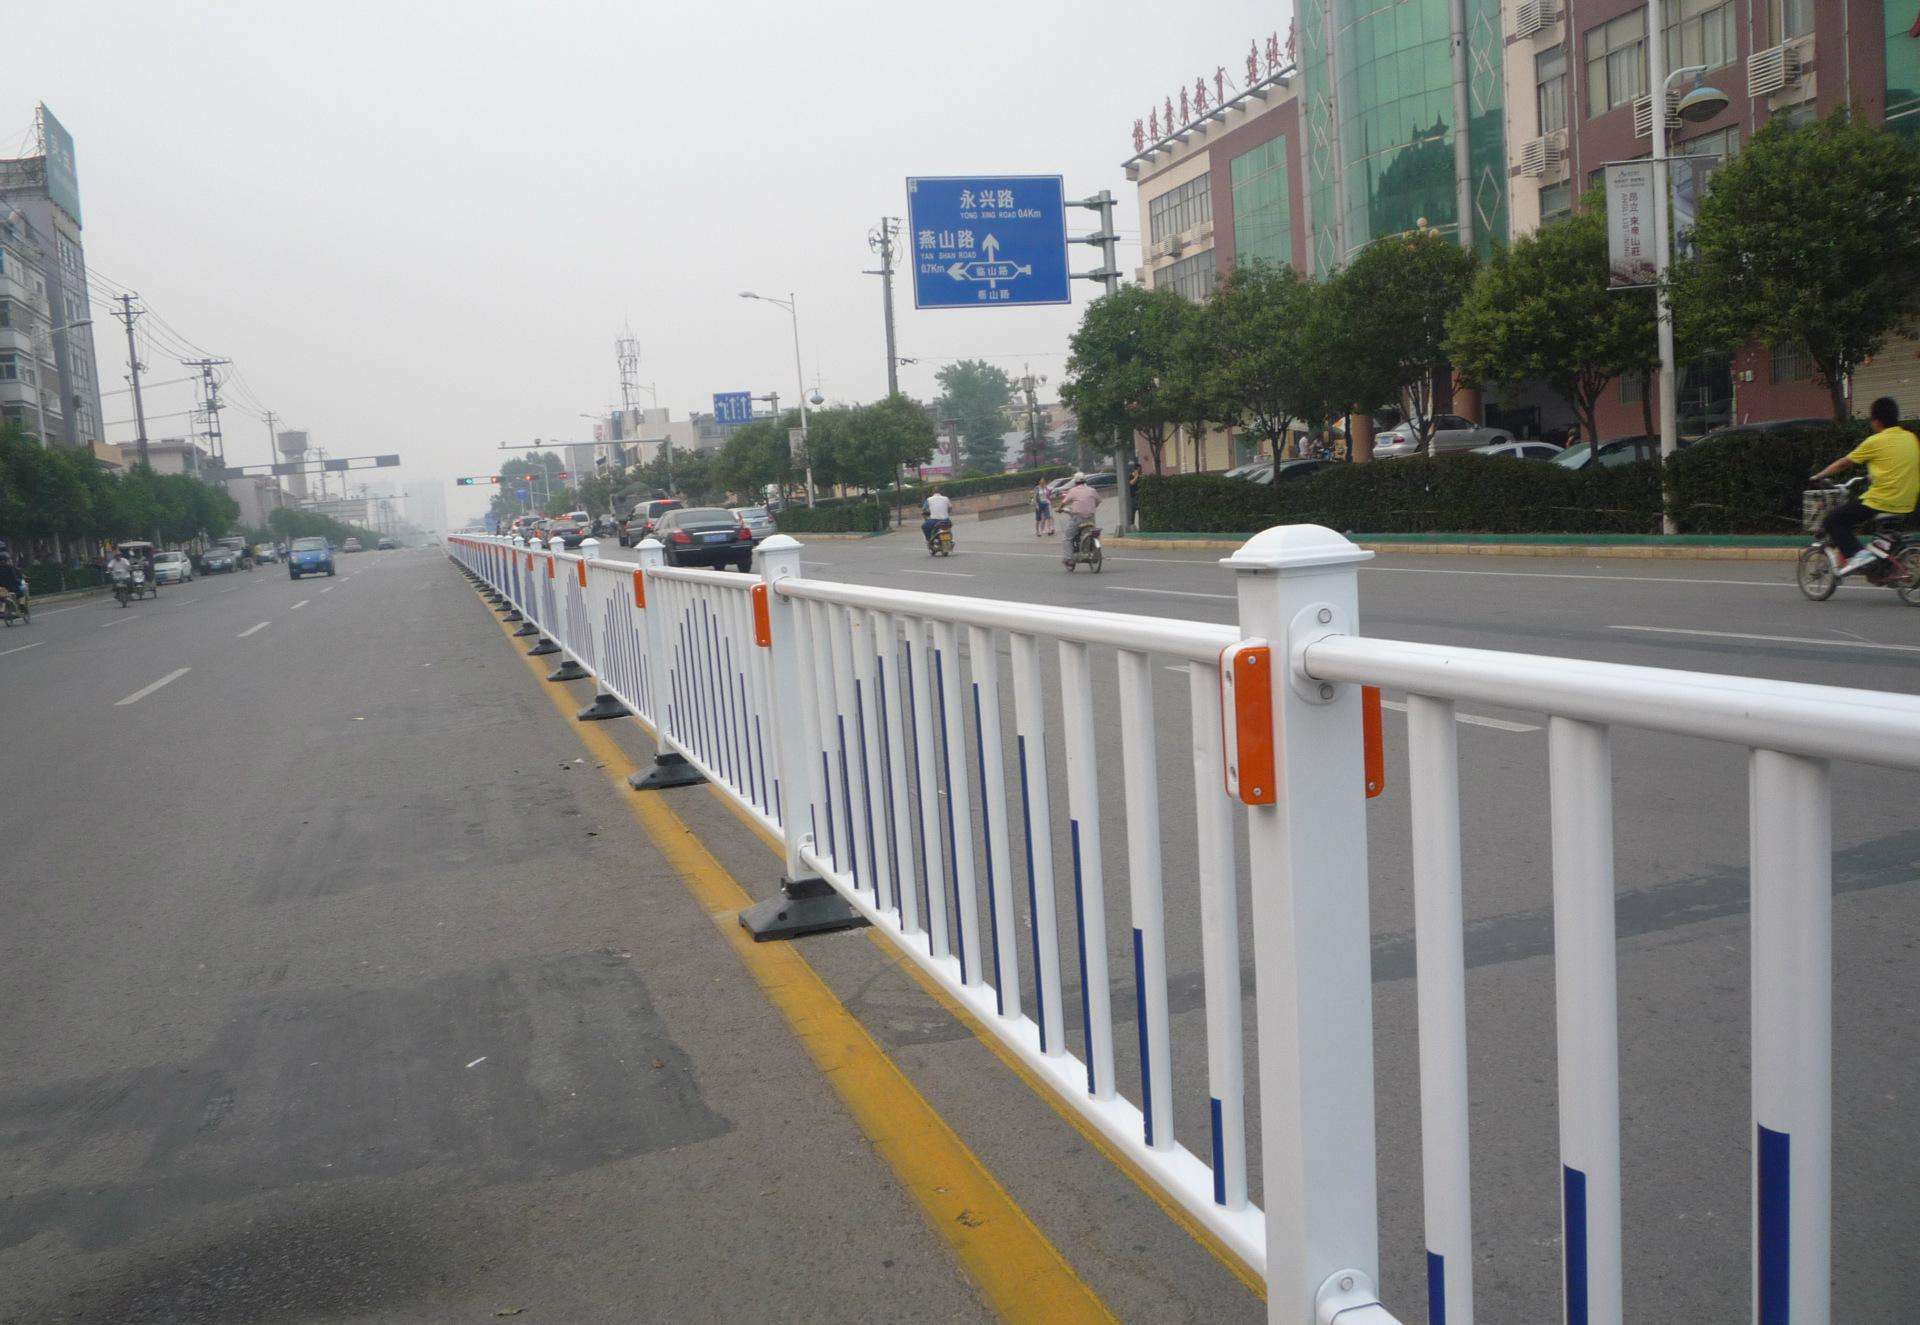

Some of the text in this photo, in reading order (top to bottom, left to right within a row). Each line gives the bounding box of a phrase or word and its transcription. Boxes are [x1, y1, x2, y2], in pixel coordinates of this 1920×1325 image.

[960, 189, 1014, 209] 永兴路
[999, 211, 1017, 219] ROAD
[918, 229, 975, 250] 燕山路
[958, 251, 977, 259] ROAD
